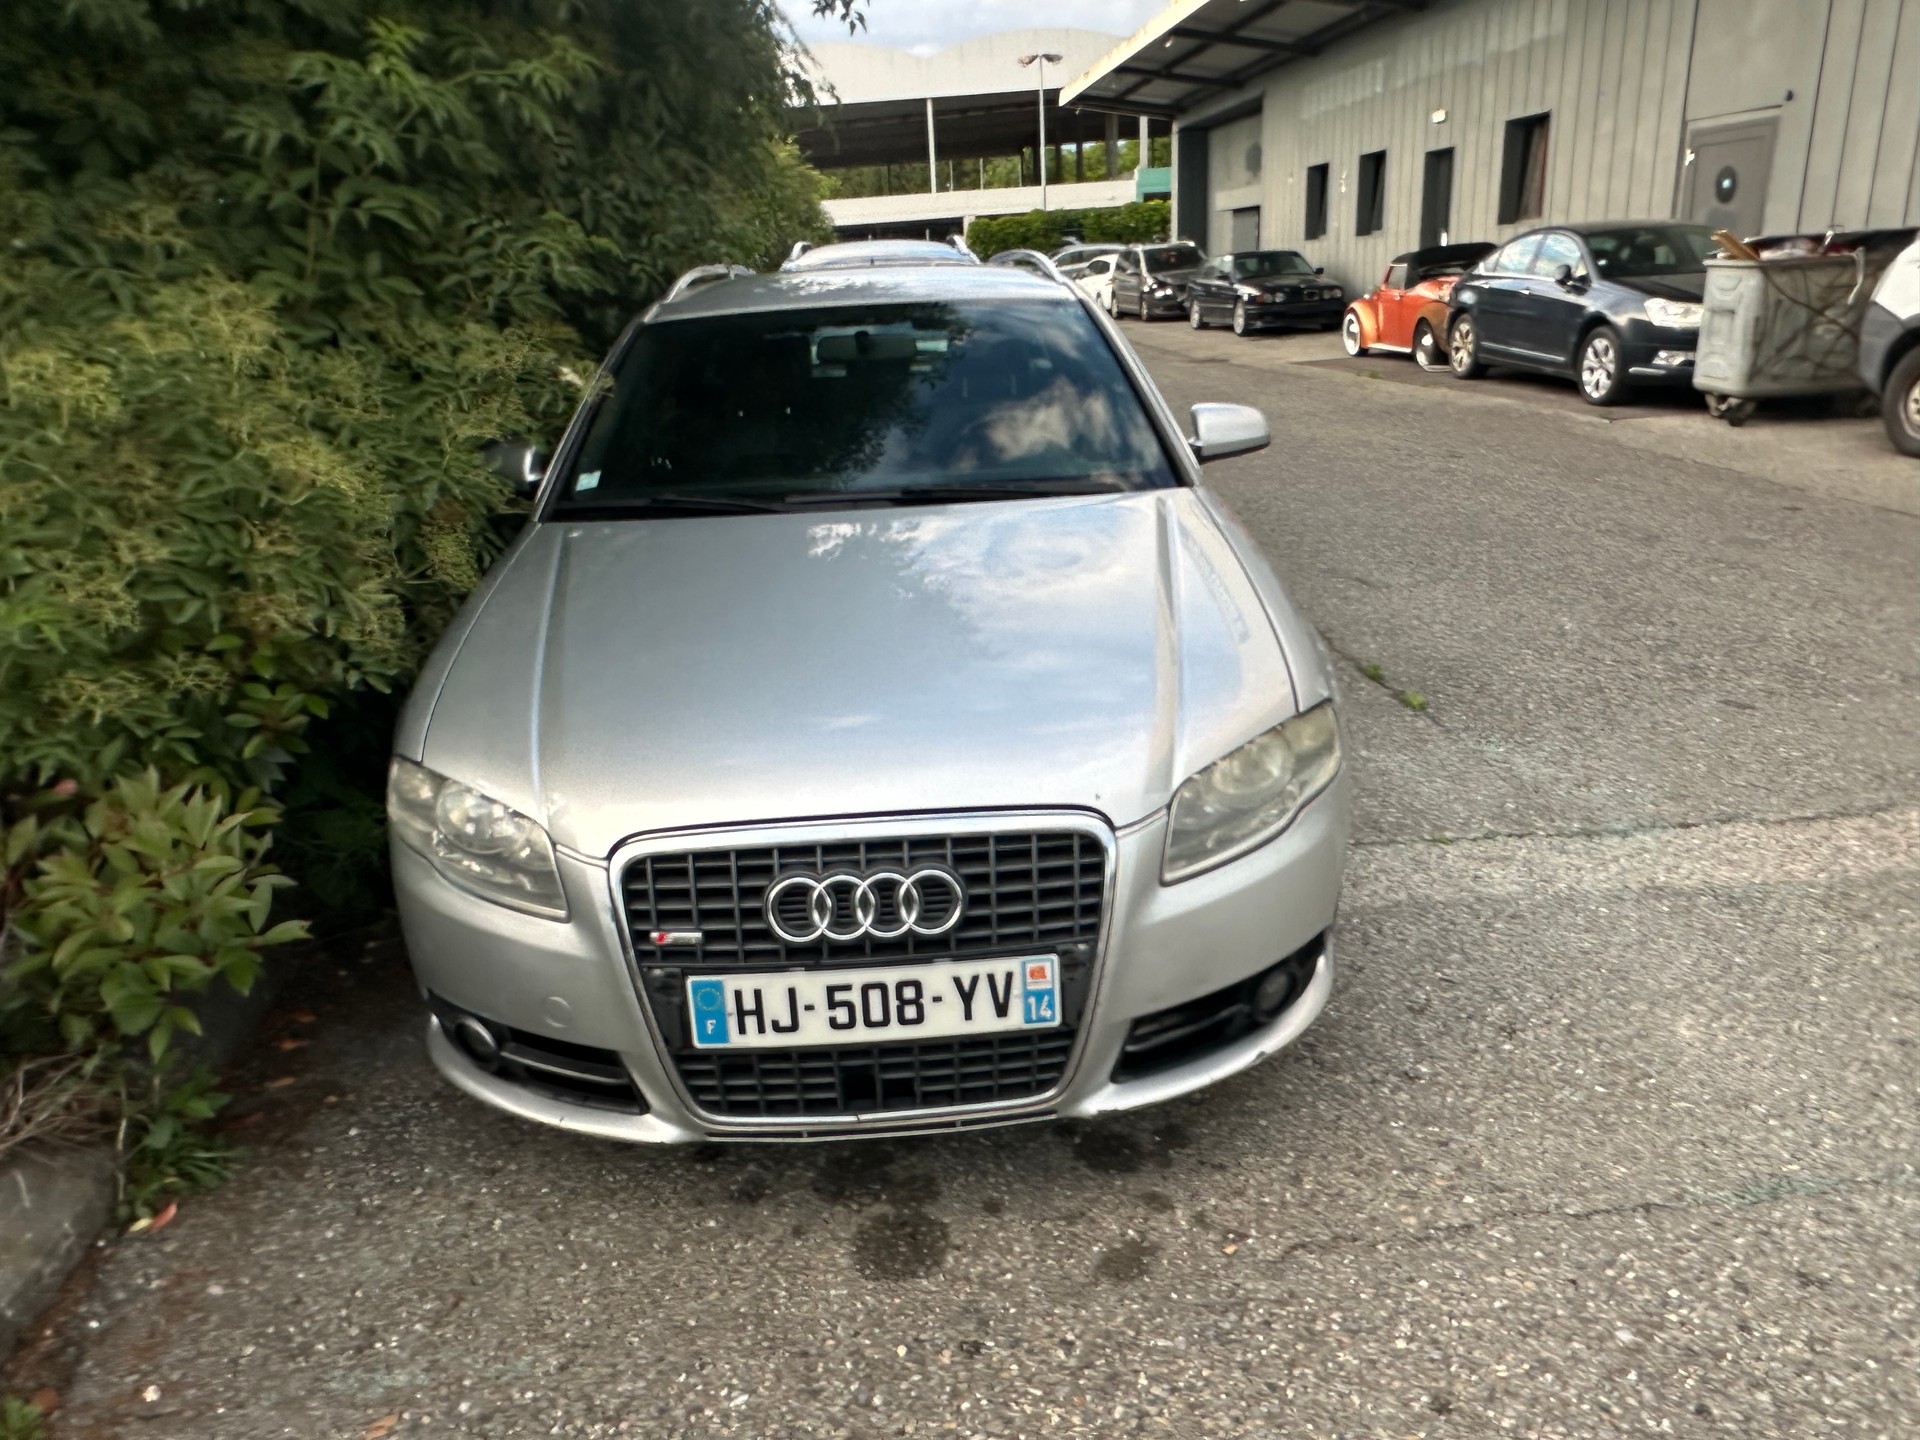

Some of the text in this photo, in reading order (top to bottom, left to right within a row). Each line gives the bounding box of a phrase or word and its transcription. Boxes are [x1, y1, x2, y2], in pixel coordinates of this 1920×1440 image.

[734, 971, 1013, 1035] HJ-508-YV
[1027, 995, 1052, 1021] 14
[706, 1019, 717, 1035] F
